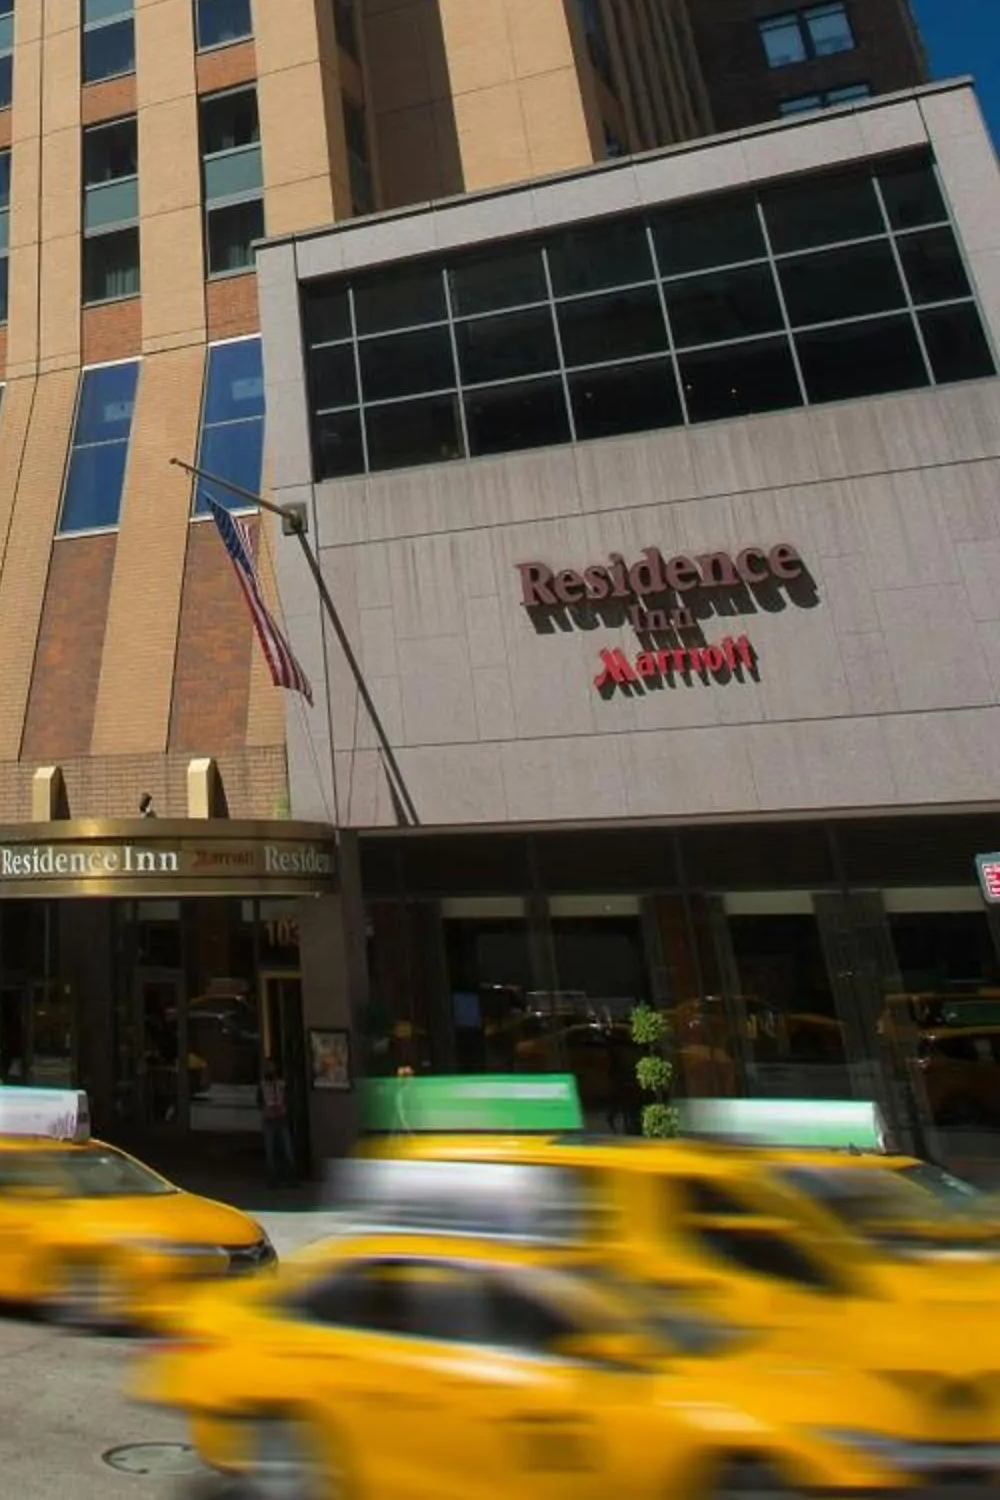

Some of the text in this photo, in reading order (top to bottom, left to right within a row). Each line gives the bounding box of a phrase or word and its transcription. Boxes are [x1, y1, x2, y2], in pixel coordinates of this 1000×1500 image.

[515, 543, 802, 606] Residence
[628, 604, 695, 633] Inn
[593, 634, 755, 688] Marriott
[2, 846, 255, 875] Residence Inn Marriott
